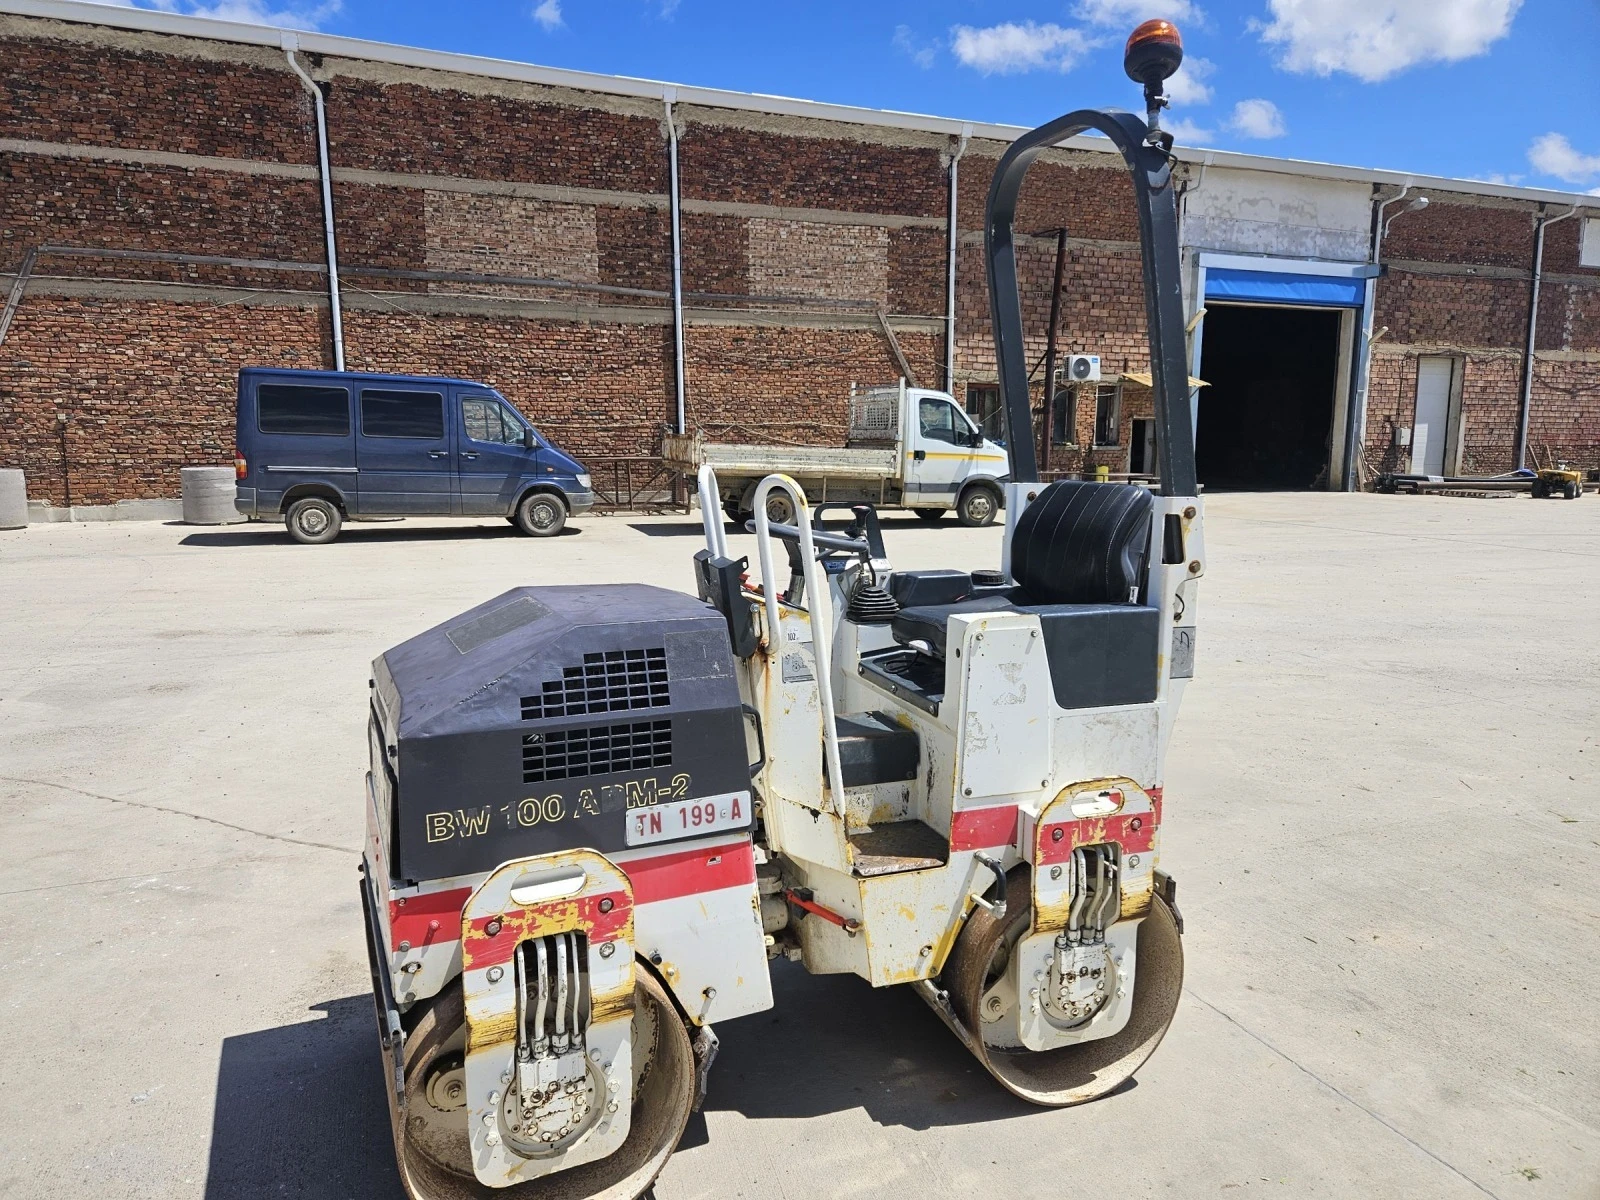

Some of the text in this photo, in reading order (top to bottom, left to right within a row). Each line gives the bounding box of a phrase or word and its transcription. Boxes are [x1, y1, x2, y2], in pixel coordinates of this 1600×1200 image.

[426, 805, 492, 843] BW
[500, 794, 566, 829] 100
[636, 798, 742, 836] TN 199 A
